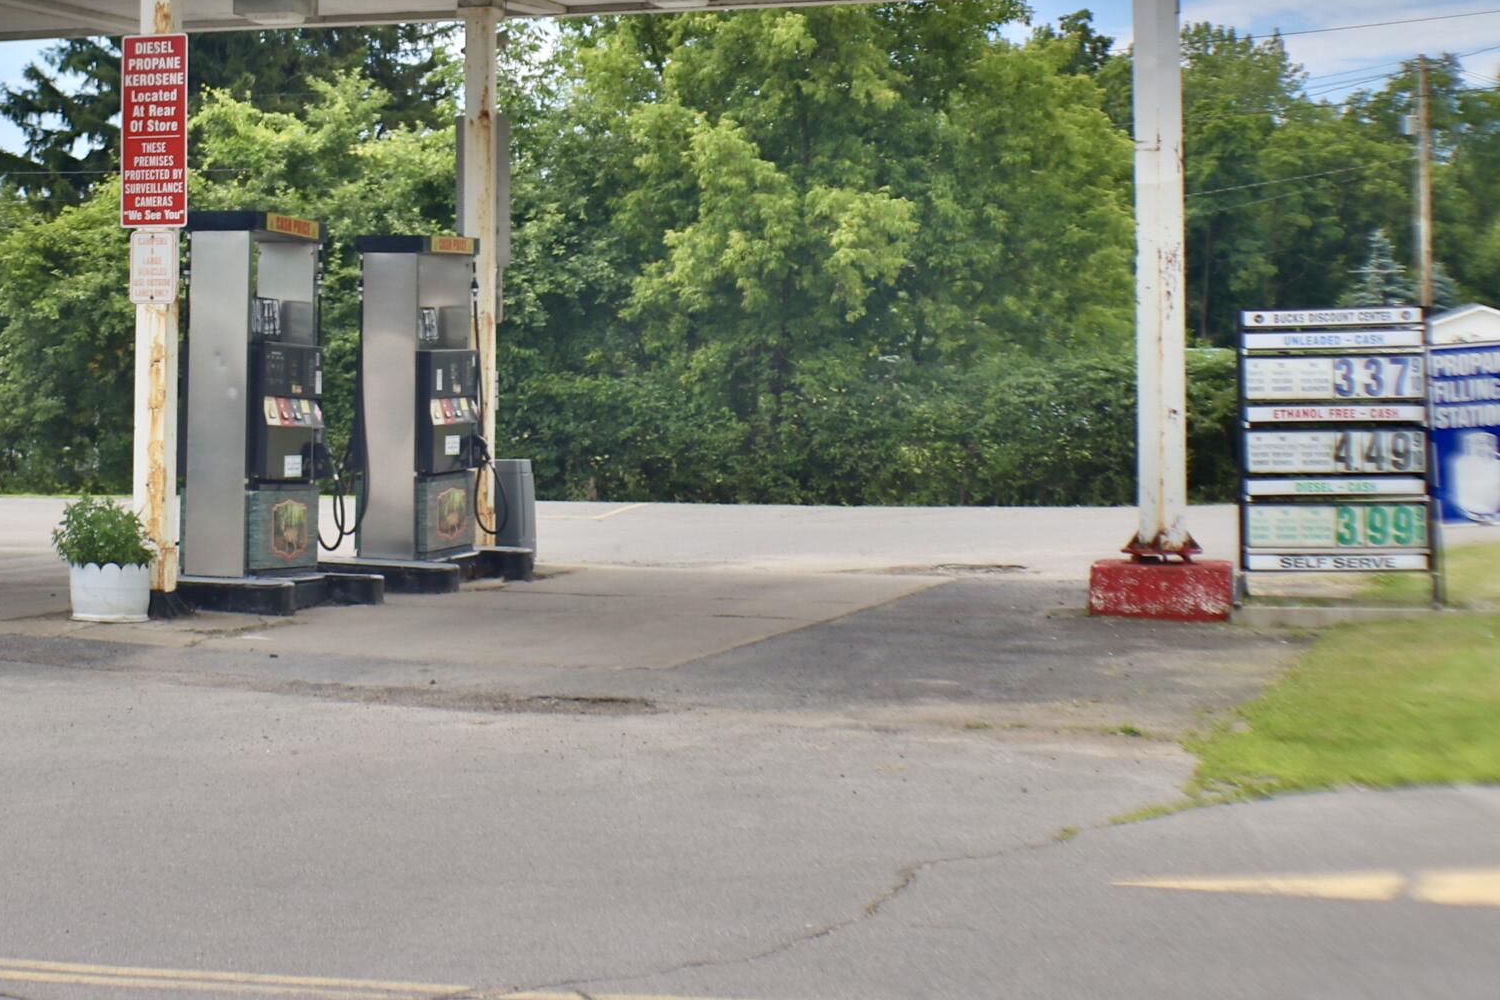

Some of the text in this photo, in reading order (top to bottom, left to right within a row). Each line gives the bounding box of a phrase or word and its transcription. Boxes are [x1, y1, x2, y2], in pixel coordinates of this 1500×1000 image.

[135, 41, 174, 54] DIESEL
[128, 56, 181, 71] PROPANE
[125, 72, 184, 87] KEROSENE
[131, 89, 177, 103] Located
[132, 105, 176, 118] At Rear
[130, 119, 178, 133] Of Store
[142, 142, 166, 153] THESE
[134, 155, 174, 167] PREMISES
[125, 168, 183, 181] PROTECTED BY
[125, 182, 183, 194] SURVEILLANCE
[135, 196, 173, 208] CAMERAS
[145, 209, 161, 220] See
[1273, 311, 1392, 324] BUCKS DISCOUNT CENTER
[1283, 335, 1341, 346] UNLEADED
[1355, 335, 1385, 345] CASH
[1334, 357, 1410, 397] 3.37
[1273, 408, 1323, 419] ETHANOL
[1329, 408, 1356, 419] FREE
[1370, 408, 1399, 418] CASH
[1334, 431, 1412, 471] 4.49
[1295, 482, 1333, 492] DIESEL
[1348, 482, 1377, 492] CASH
[1336, 505, 1414, 545] 3.99
[1279, 557, 1397, 569] SELF SERVE
